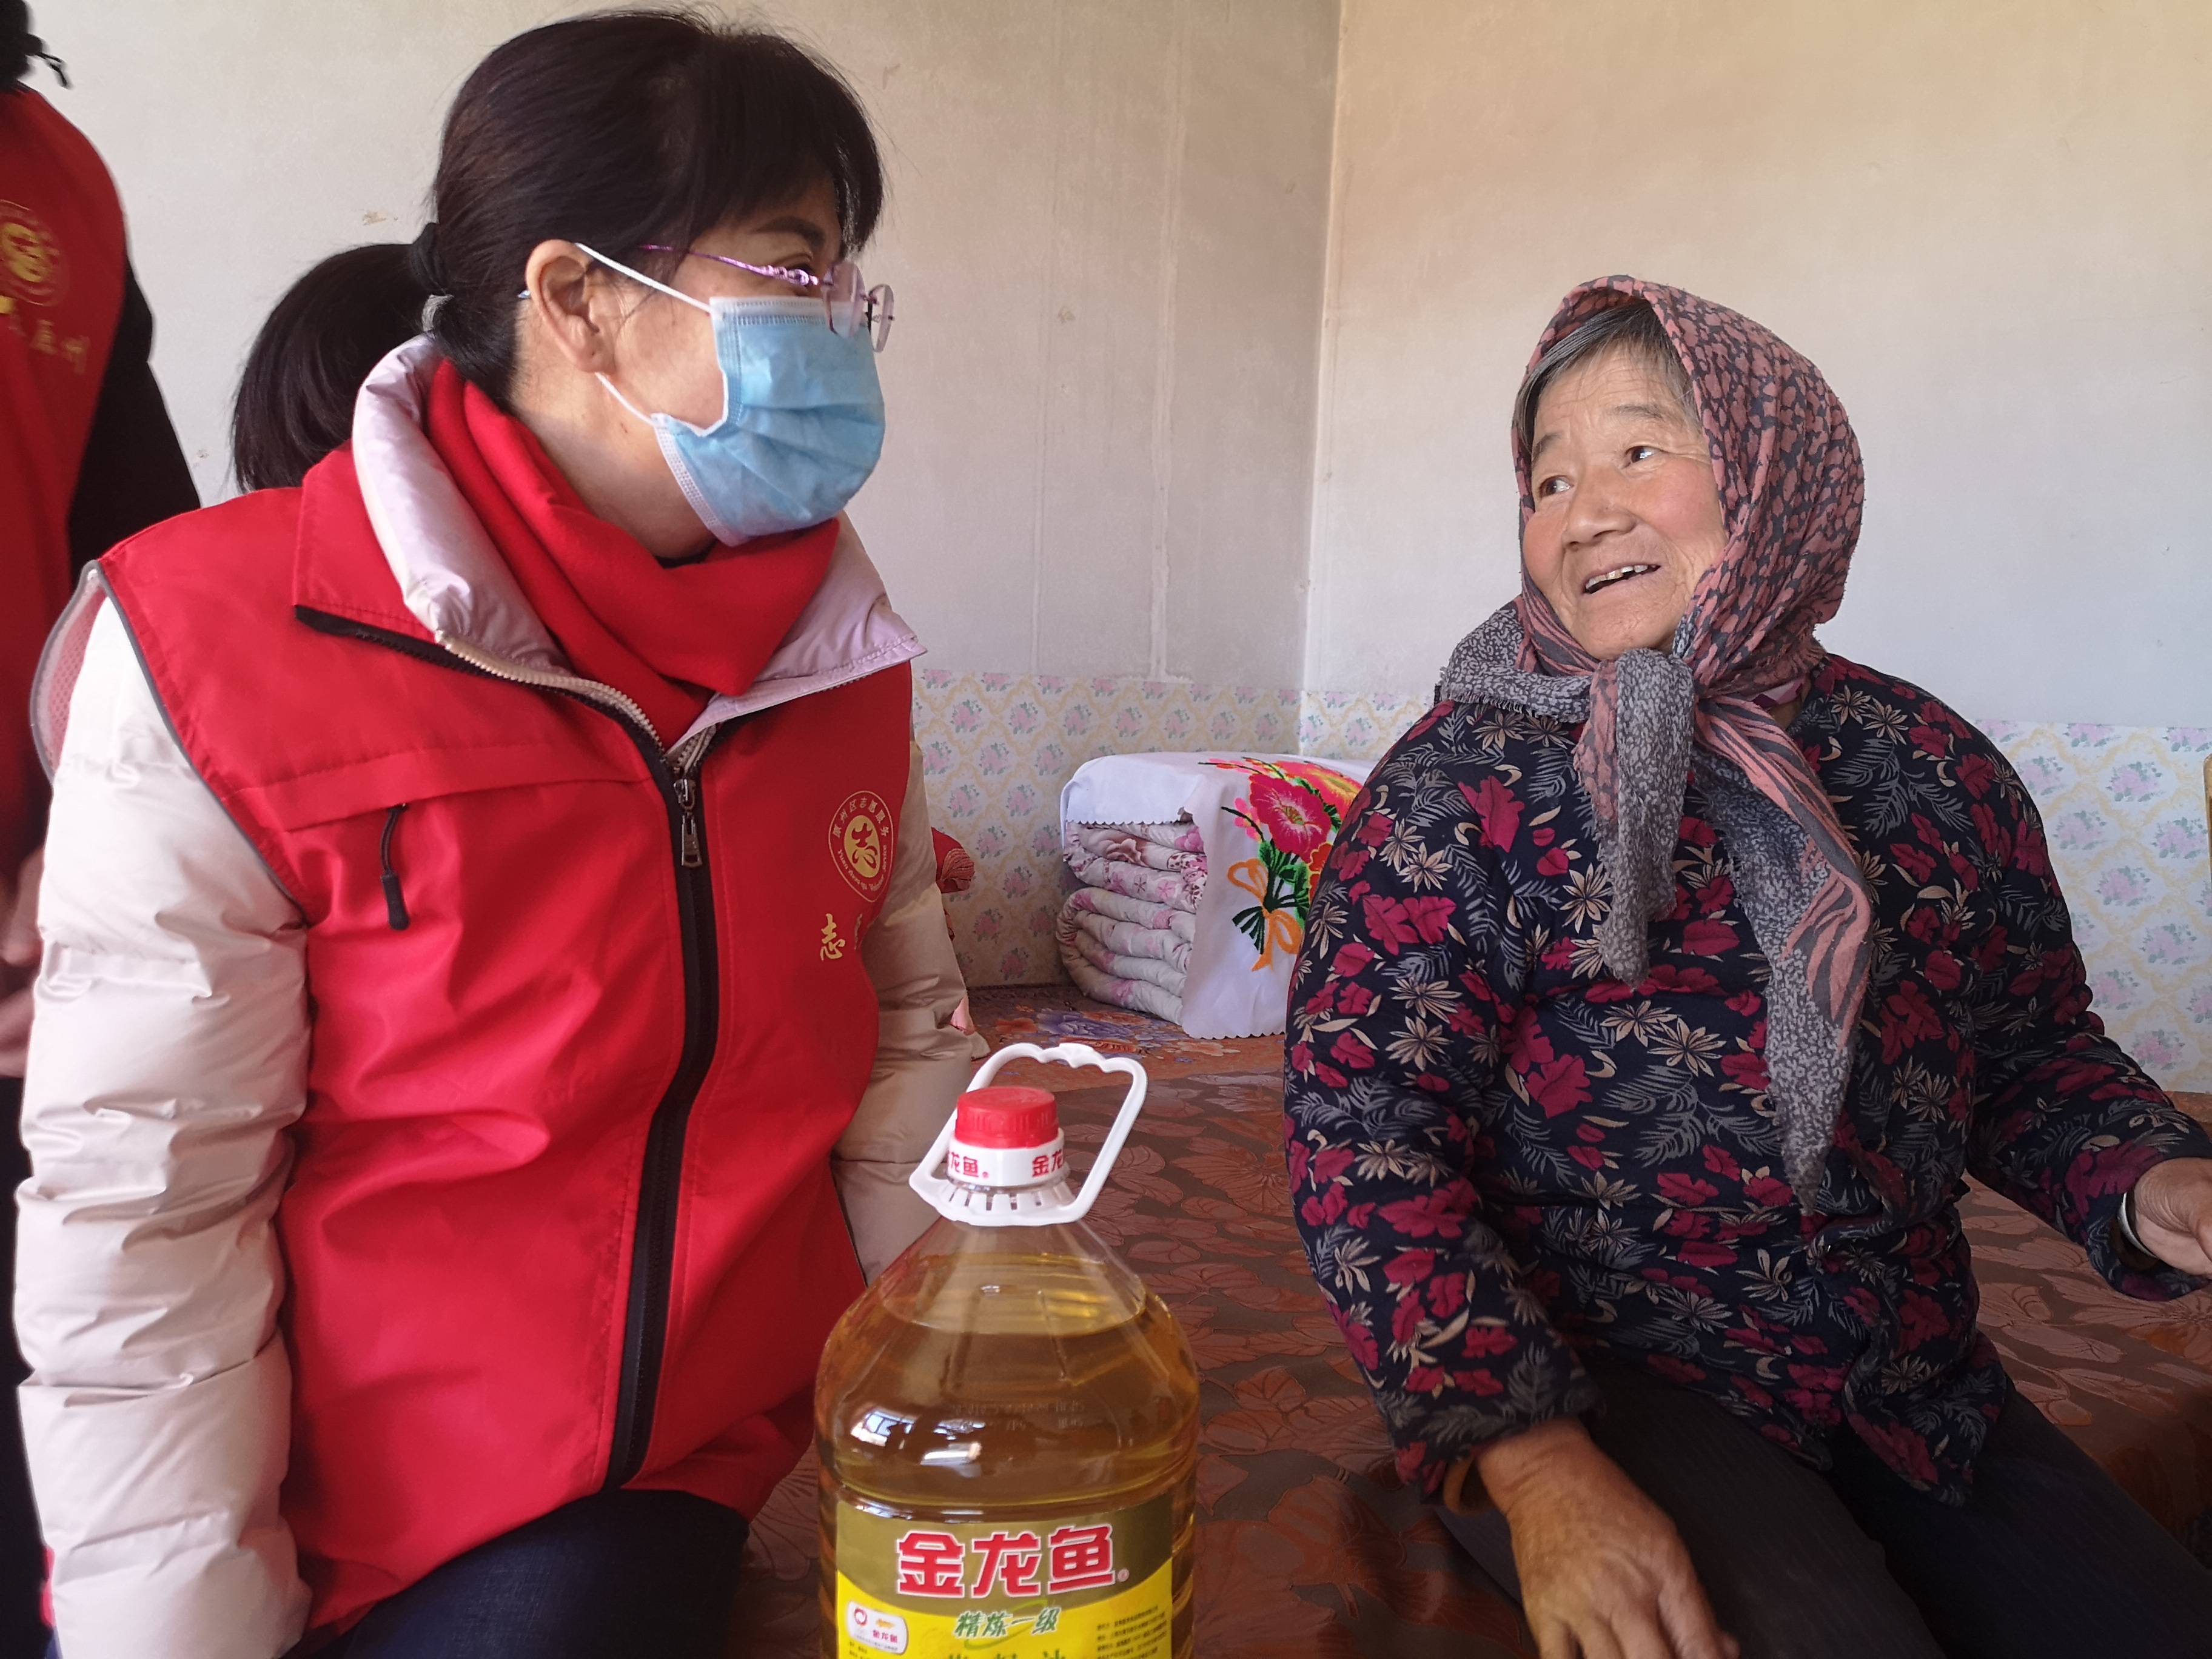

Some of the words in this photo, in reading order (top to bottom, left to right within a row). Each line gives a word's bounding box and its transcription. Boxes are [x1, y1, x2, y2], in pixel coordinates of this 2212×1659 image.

[948, 1152, 979, 1178] 龙鱼
[897, 1524, 1114, 1598] 金龙鱼
[954, 1607, 1061, 1637] 精炼一级
